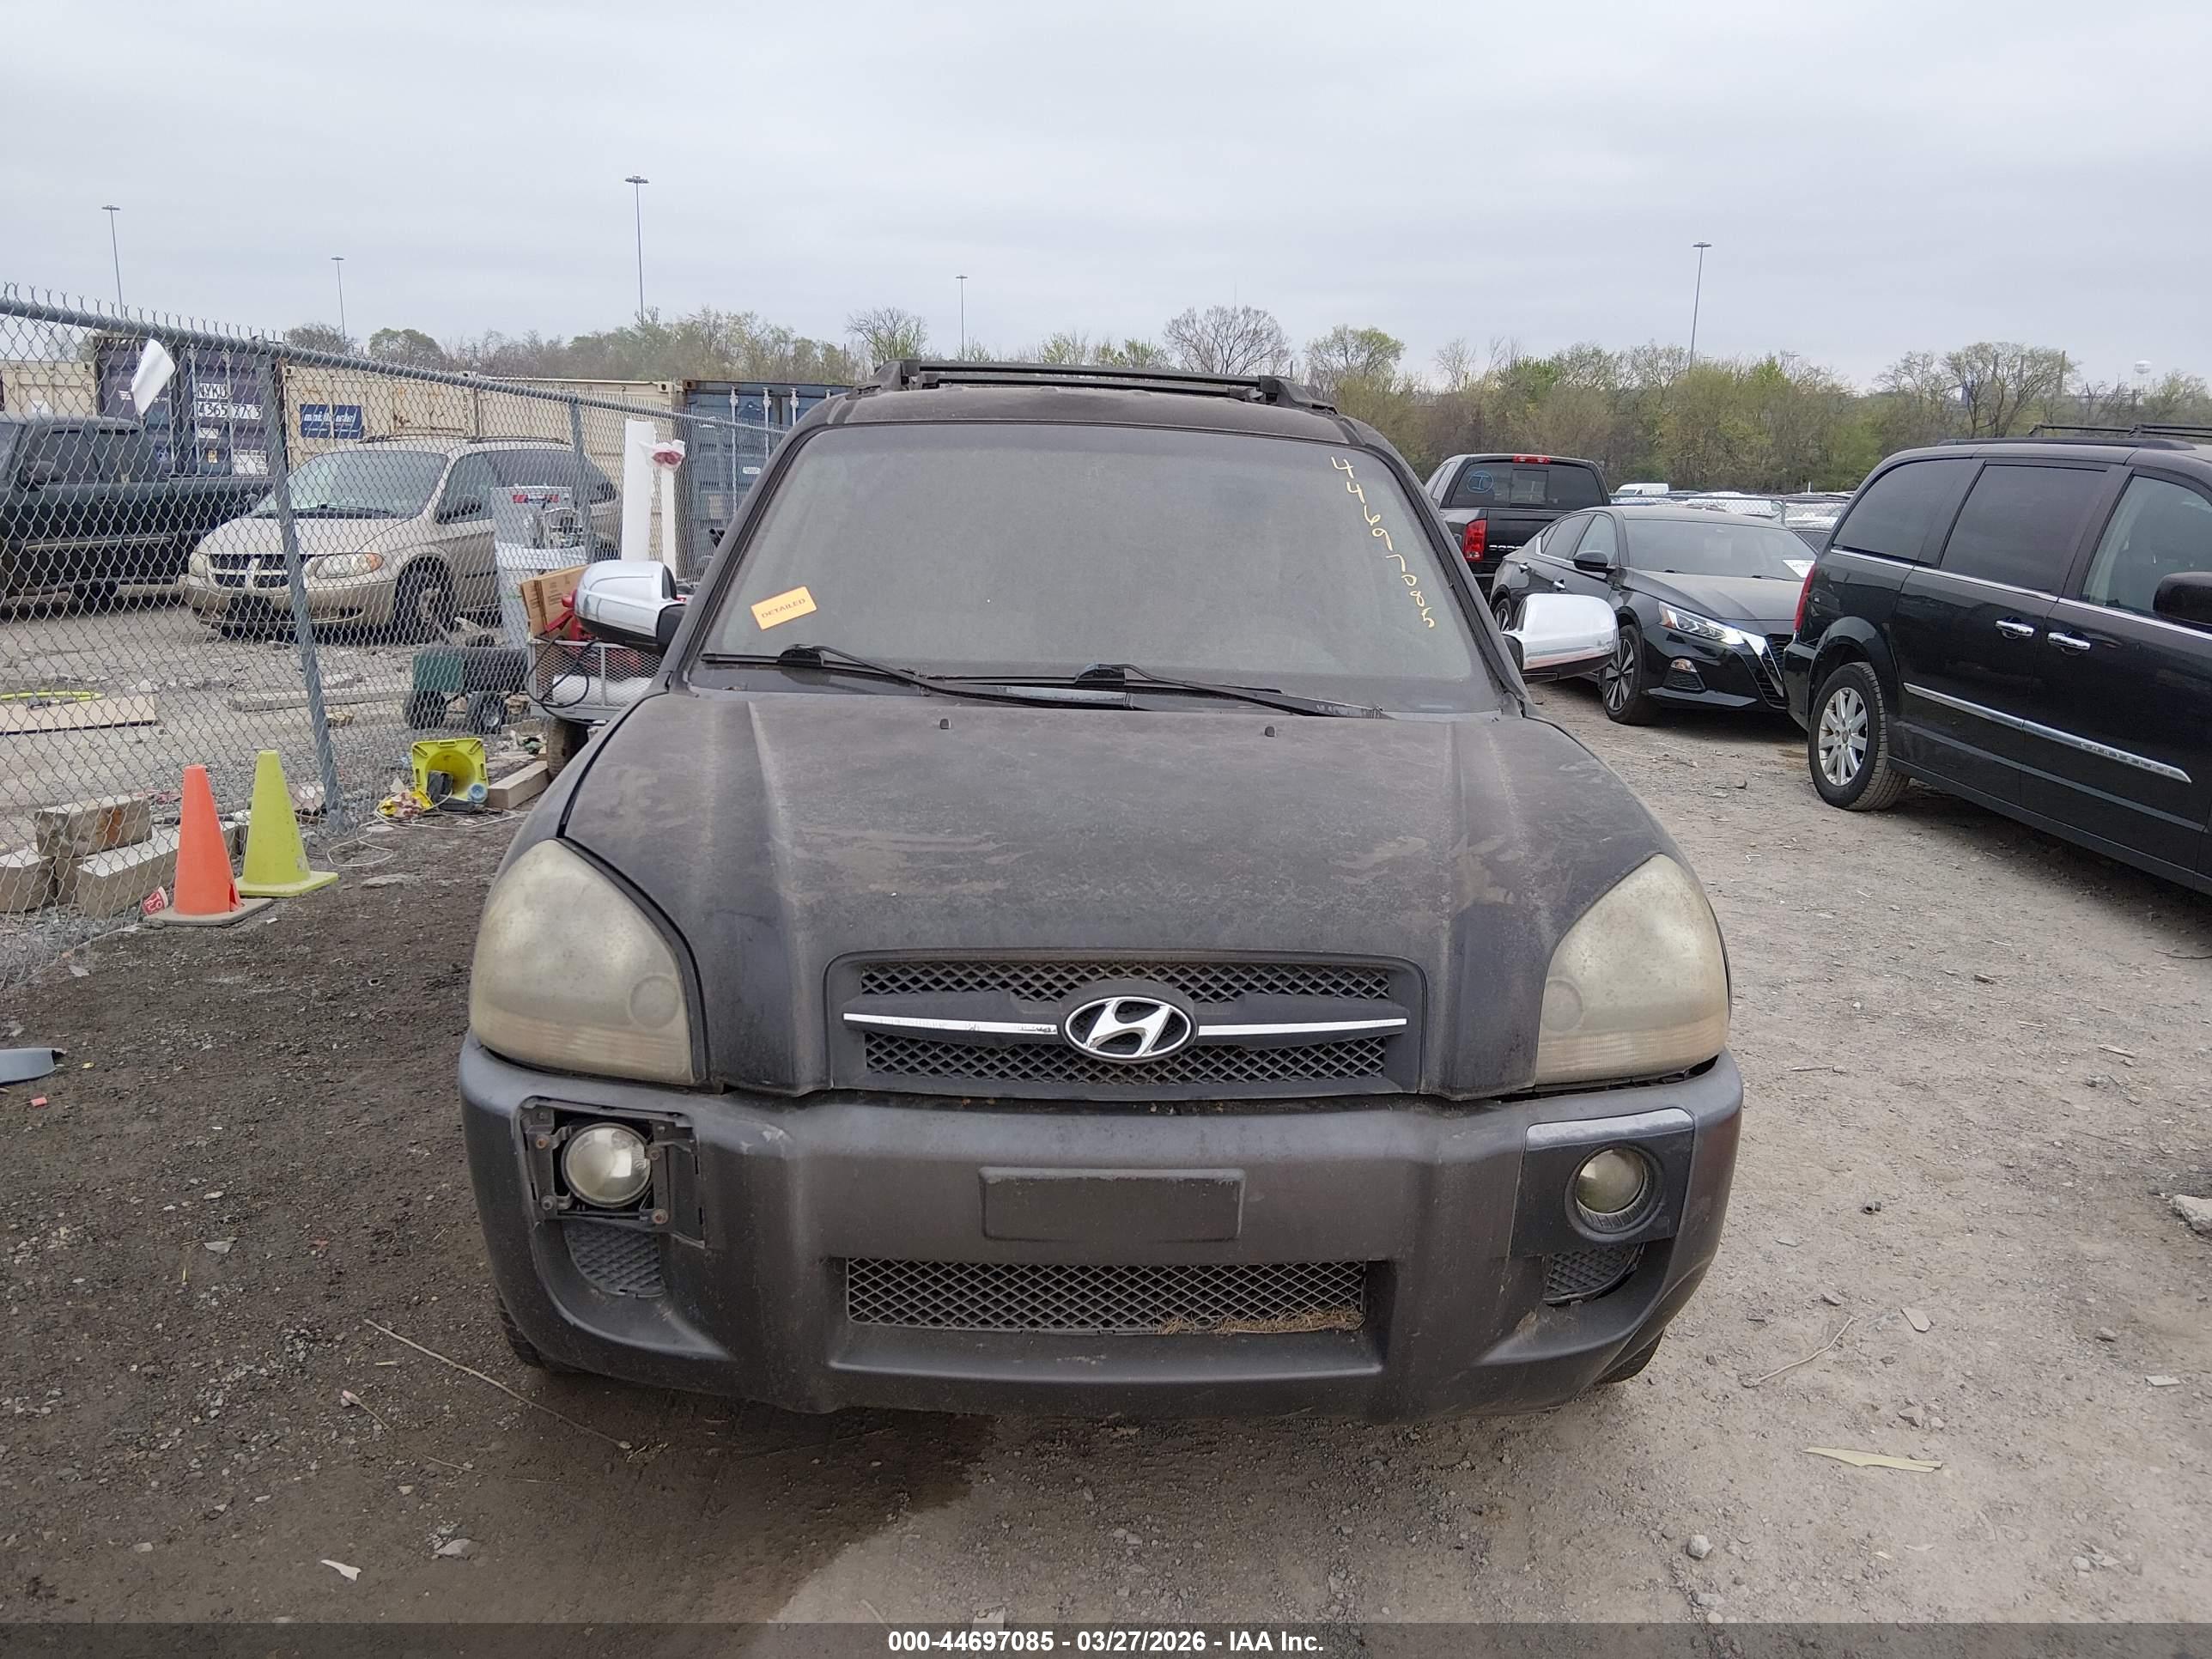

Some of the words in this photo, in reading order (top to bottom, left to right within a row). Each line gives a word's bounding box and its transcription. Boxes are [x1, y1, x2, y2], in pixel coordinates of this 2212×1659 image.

[197, 384, 228, 398] NYKU
[1331, 456, 1435, 628] 44697085
[761, 598, 806, 618] DETAILED
[2080, 741, 2172, 775] CHRYSLER
